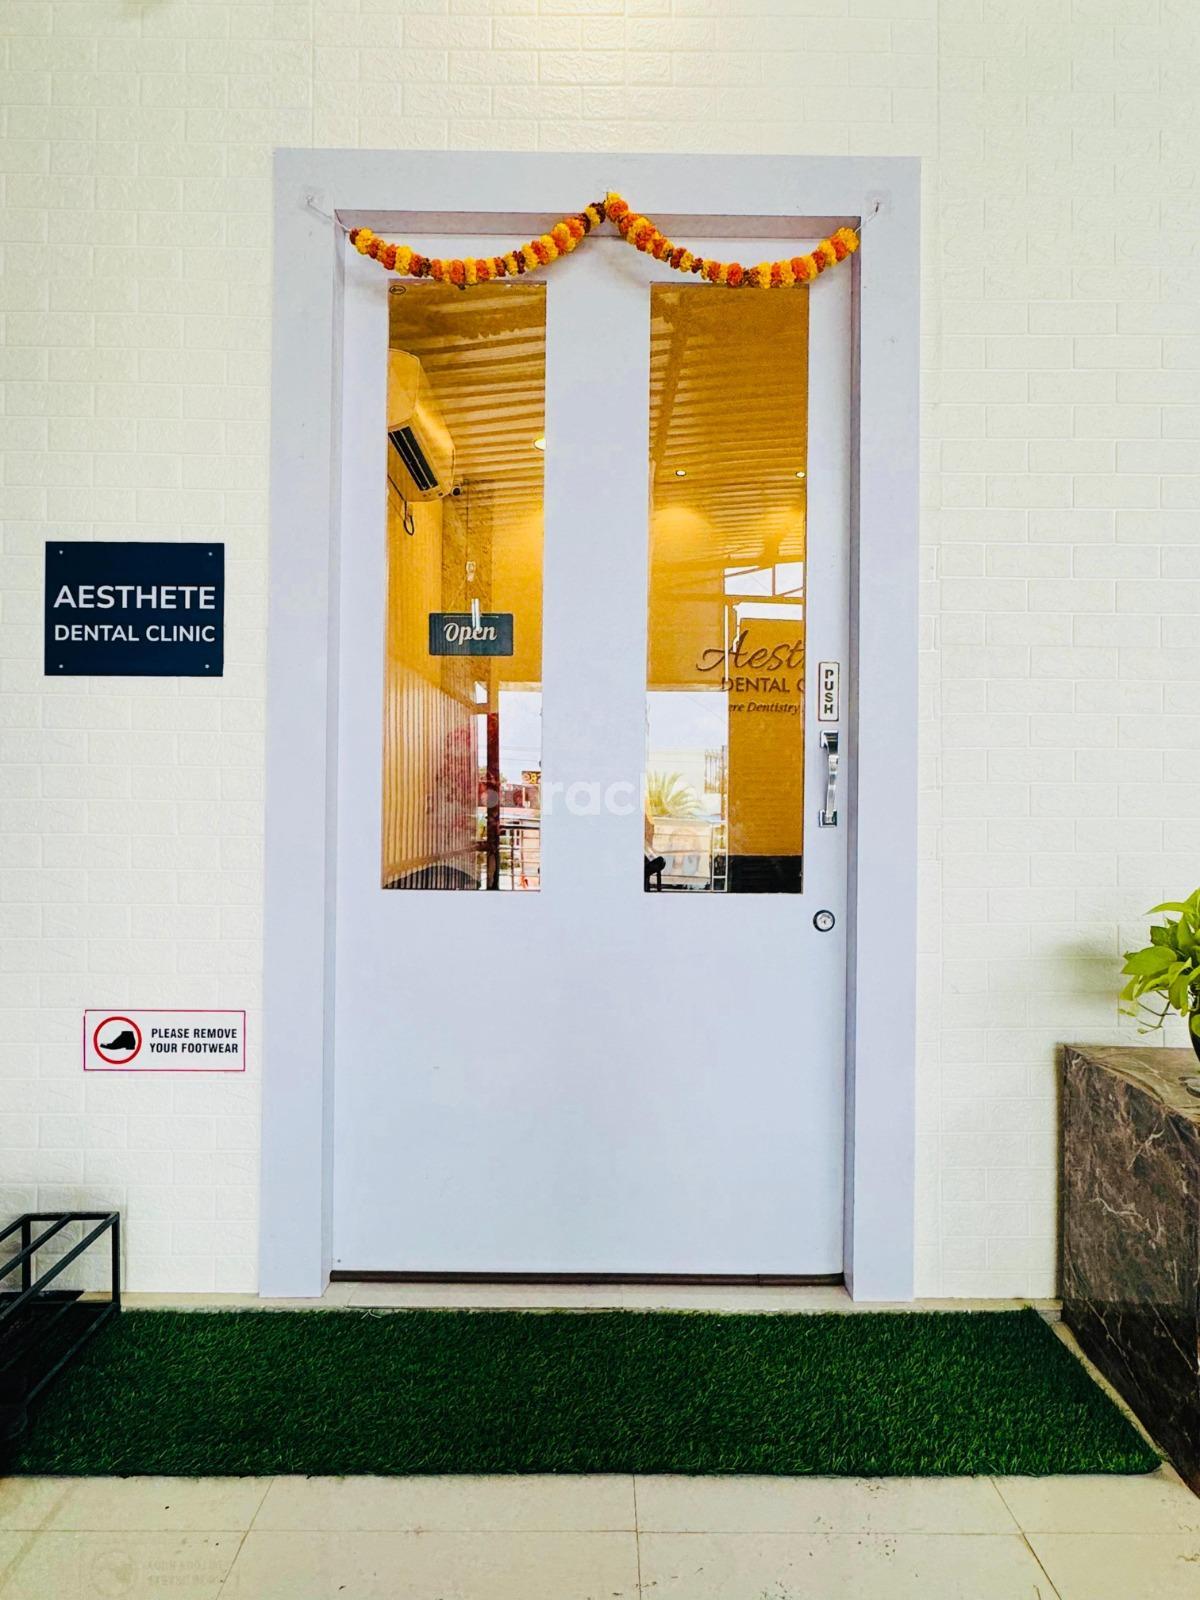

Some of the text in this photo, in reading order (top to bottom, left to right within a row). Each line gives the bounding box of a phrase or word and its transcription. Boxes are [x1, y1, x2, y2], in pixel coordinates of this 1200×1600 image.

[53, 585, 216, 610] AESTHETE
[54, 624, 216, 642] DENTAL CLINIC
[443, 622, 498, 645] Open
[696, 629, 805, 672] Aest
[721, 677, 791, 693] DENTAL
[824, 669, 834, 714] PUSH
[747, 702, 800, 716] Dentistry
[151, 1028, 237, 1039] PLEASE REMOVE
[150, 1042, 239, 1053] YOUR FOOTWEAR
